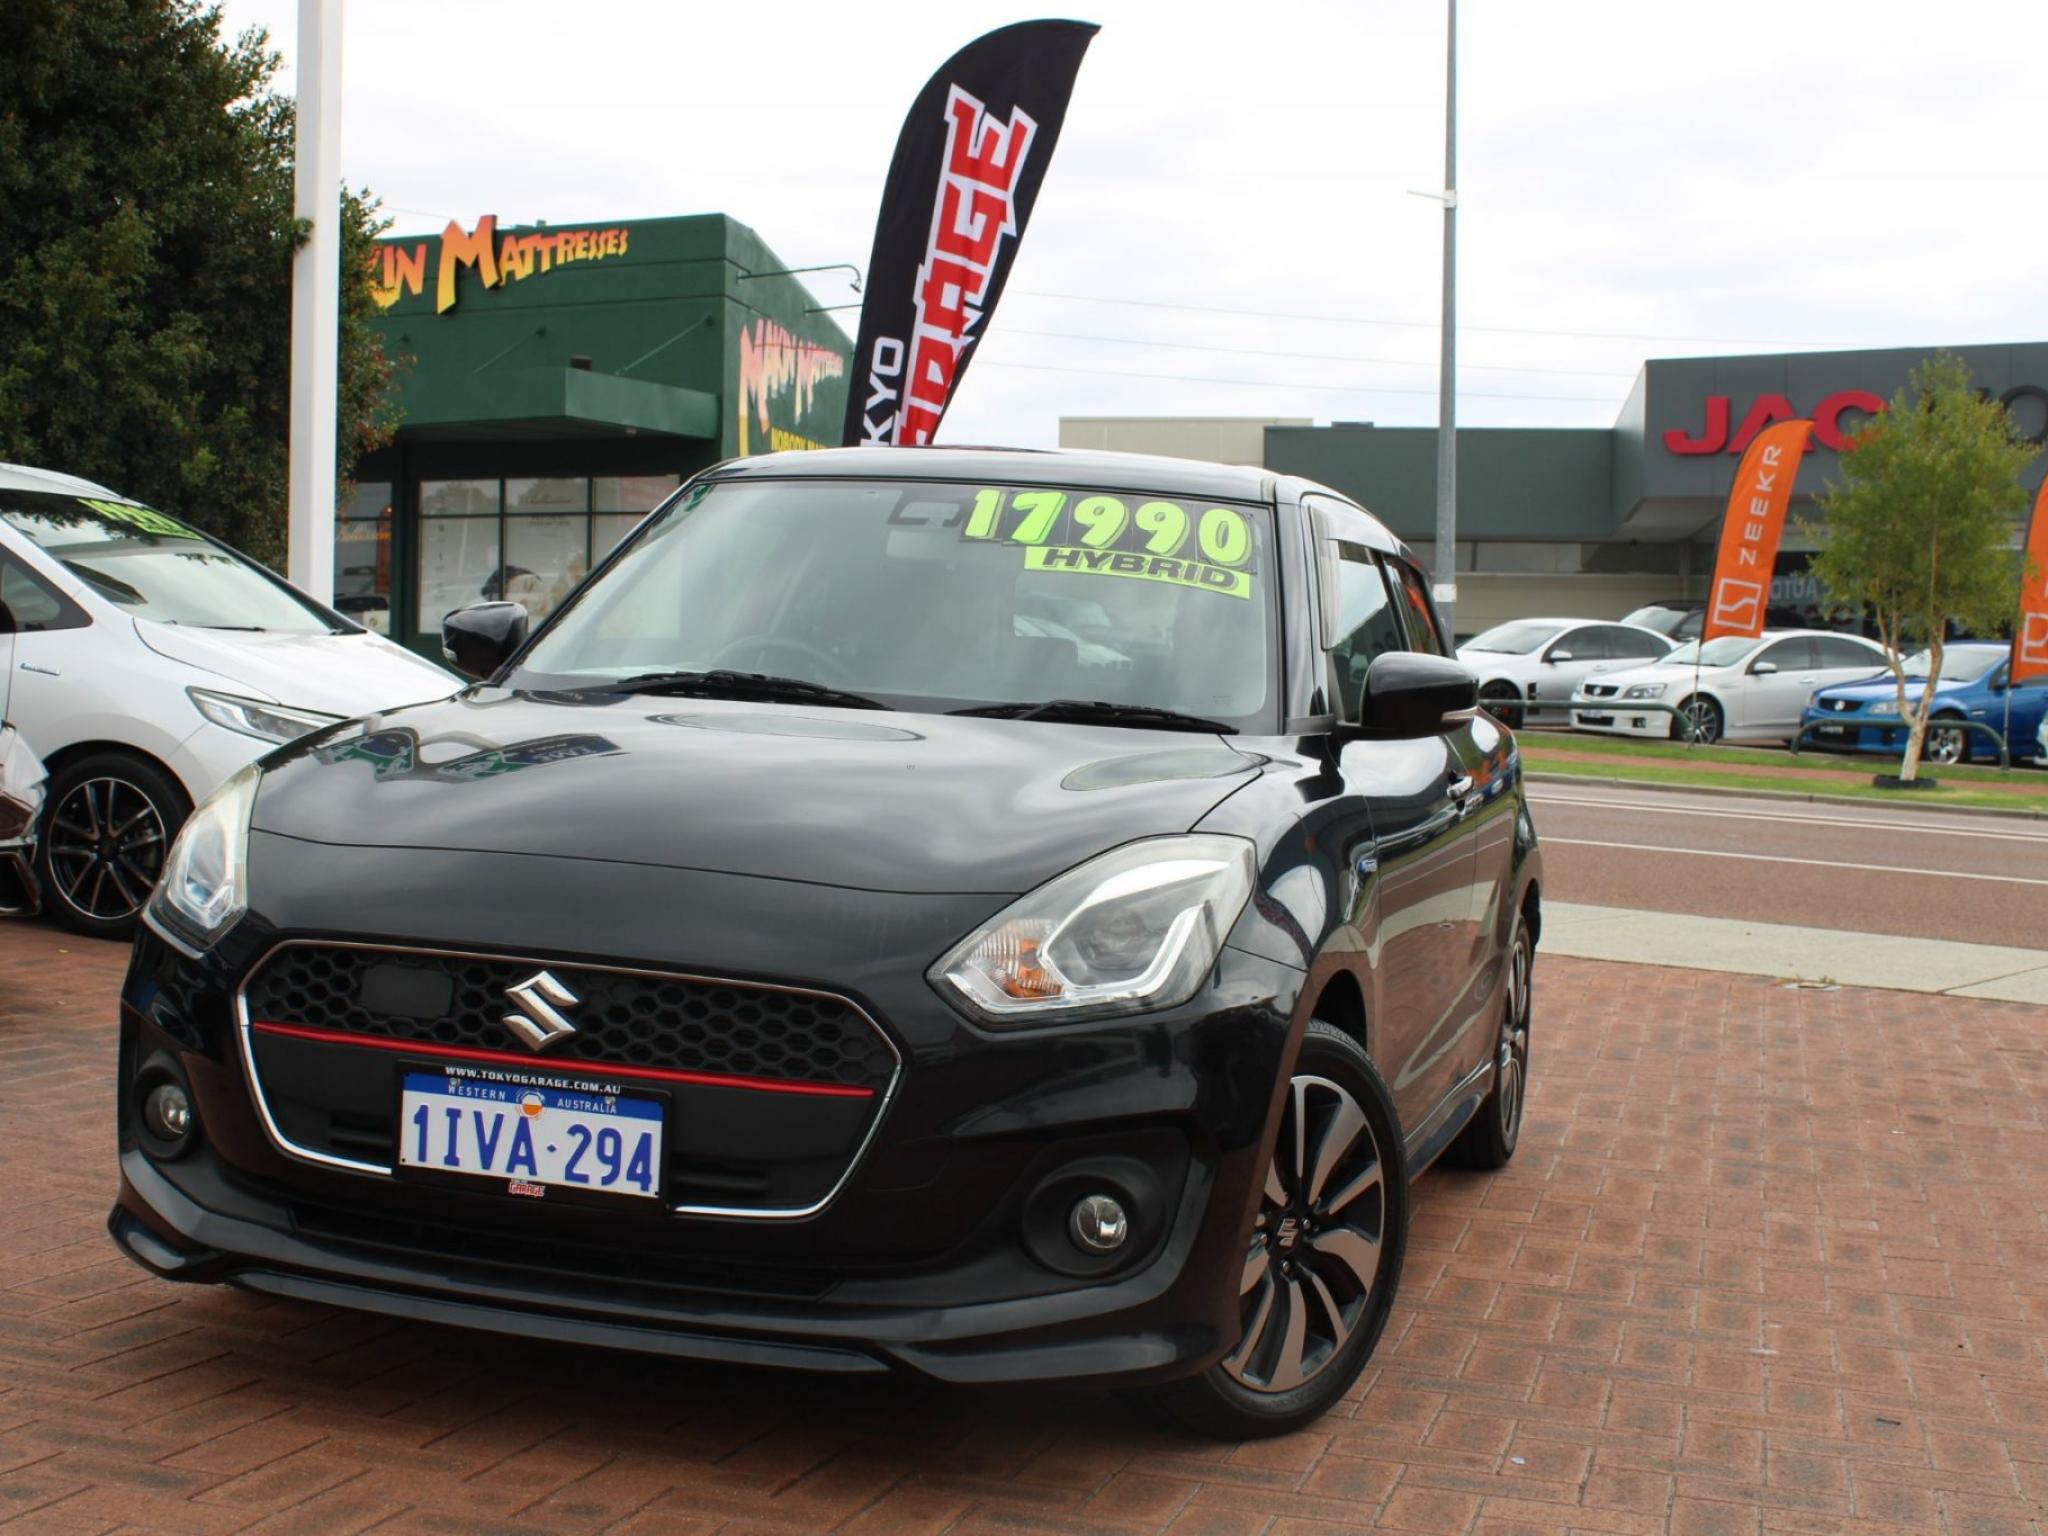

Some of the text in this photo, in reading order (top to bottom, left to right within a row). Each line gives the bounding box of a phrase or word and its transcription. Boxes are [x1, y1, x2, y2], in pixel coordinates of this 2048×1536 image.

[436, 214, 629, 315] MATTRESSES
[1662, 390, 1888, 454] JAC
[965, 488, 1252, 566] 17990
[1739, 445, 1782, 566] ZEEKR
[1042, 548, 1239, 590] HYBRID
[445, 1066, 621, 1095] WWW.TOKYOGARAGE.COM.AU
[447, 1084, 617, 1114] WESTERN AUSTRALIA
